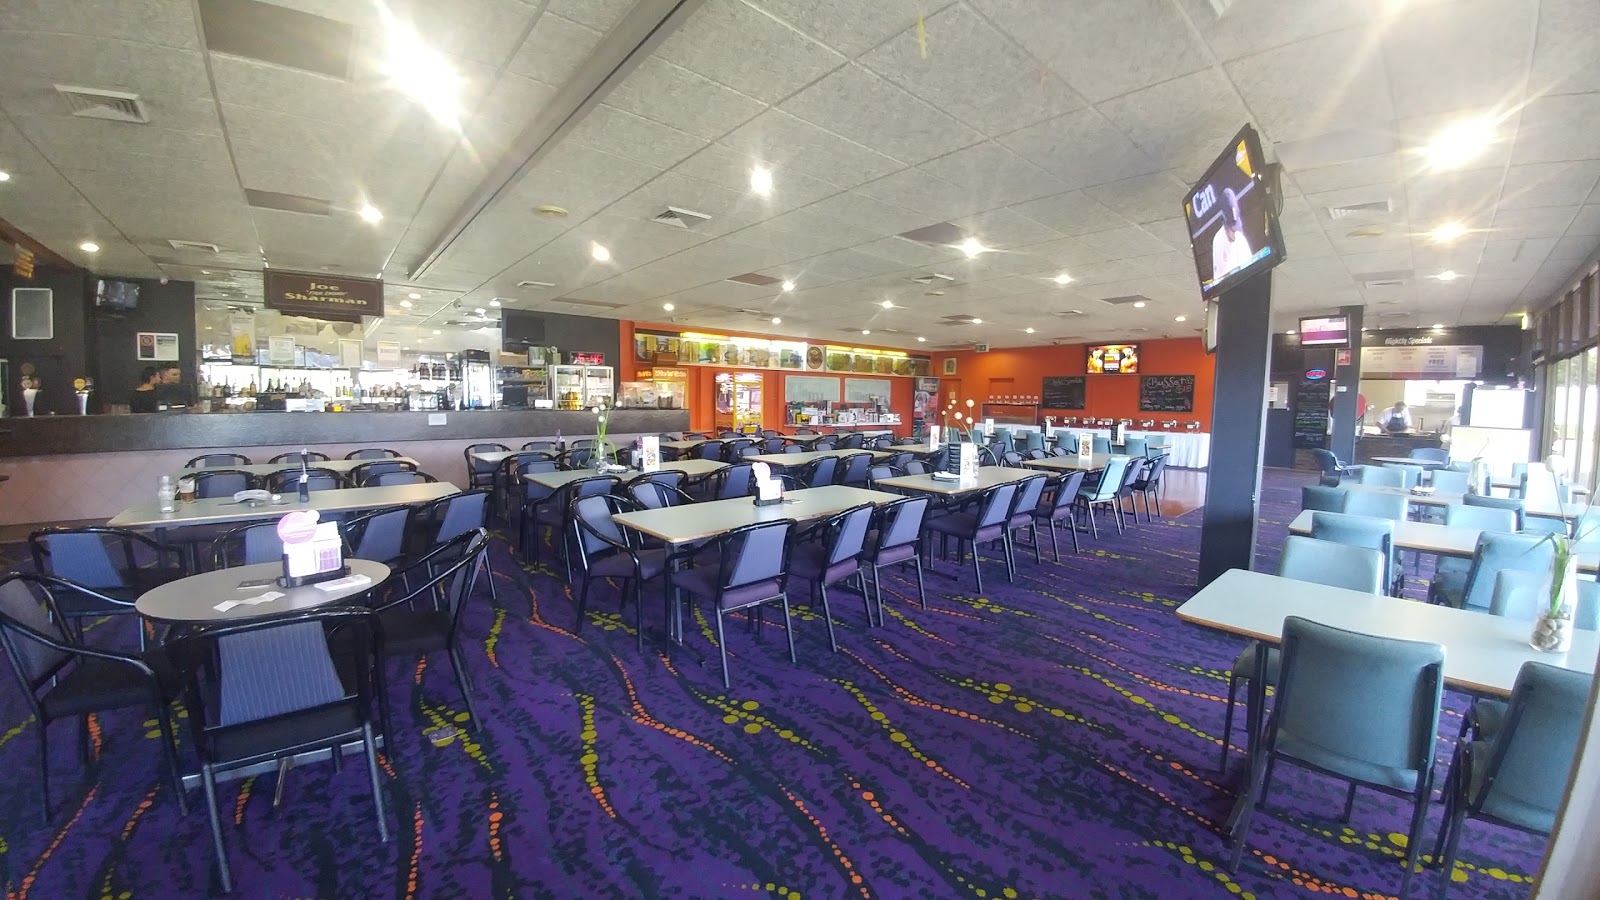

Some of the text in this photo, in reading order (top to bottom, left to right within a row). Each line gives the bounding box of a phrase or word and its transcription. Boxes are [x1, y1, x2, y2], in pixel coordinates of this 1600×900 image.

[1192, 184, 1216, 218] Can
[309, 282, 340, 291] Joe
[284, 292, 368, 305] Sharman
[1384, 336, 1433, 345] Nightly Specials
